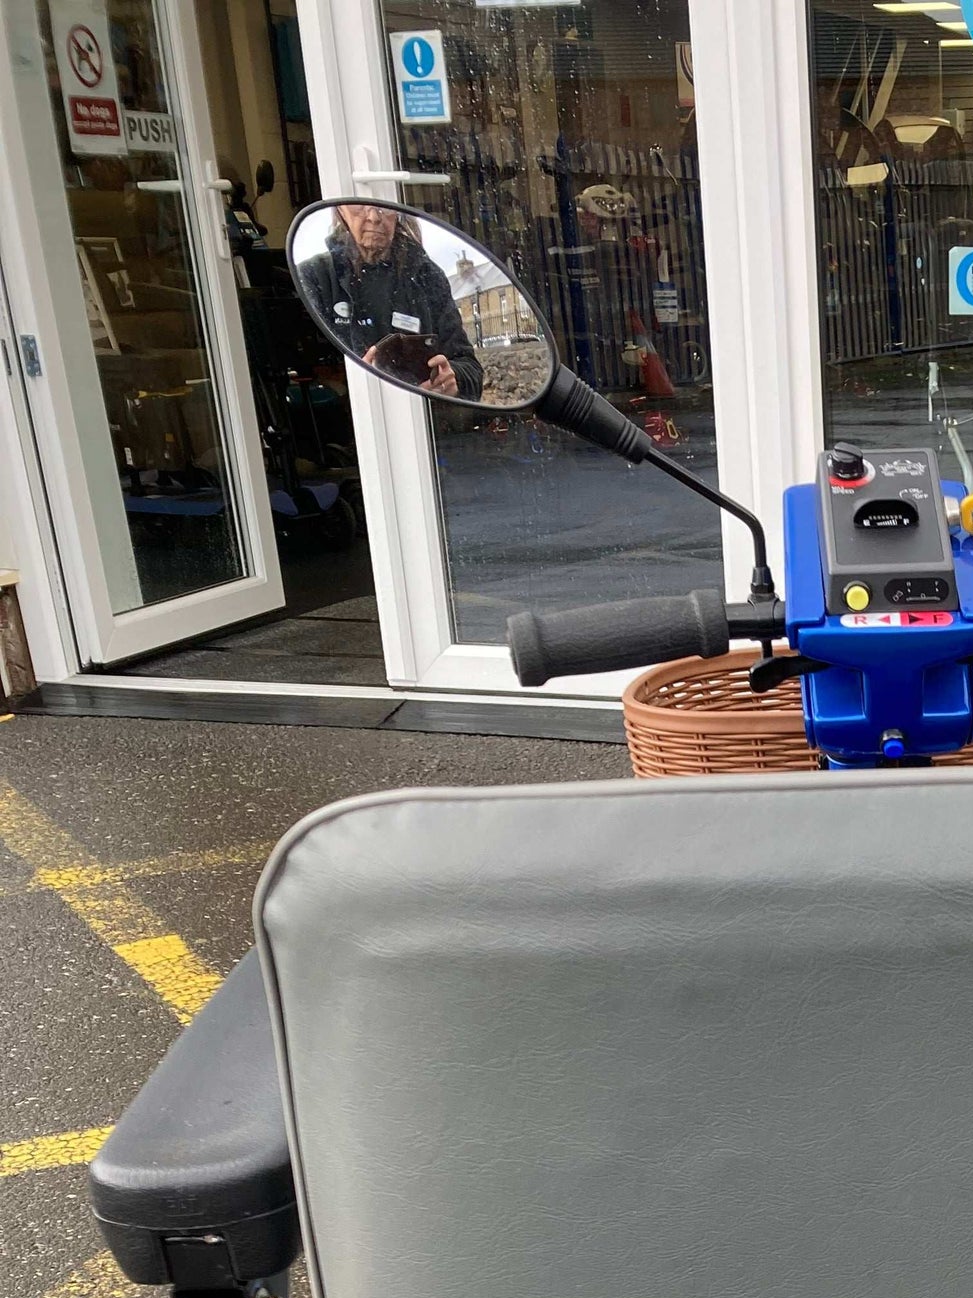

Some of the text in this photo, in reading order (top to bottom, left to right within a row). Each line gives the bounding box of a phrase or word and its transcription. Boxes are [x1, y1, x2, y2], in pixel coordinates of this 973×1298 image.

[76, 102, 90, 117] No
[126, 117, 173, 143] PUSH
[854, 616, 868, 625] R
[933, 614, 944, 624] F
